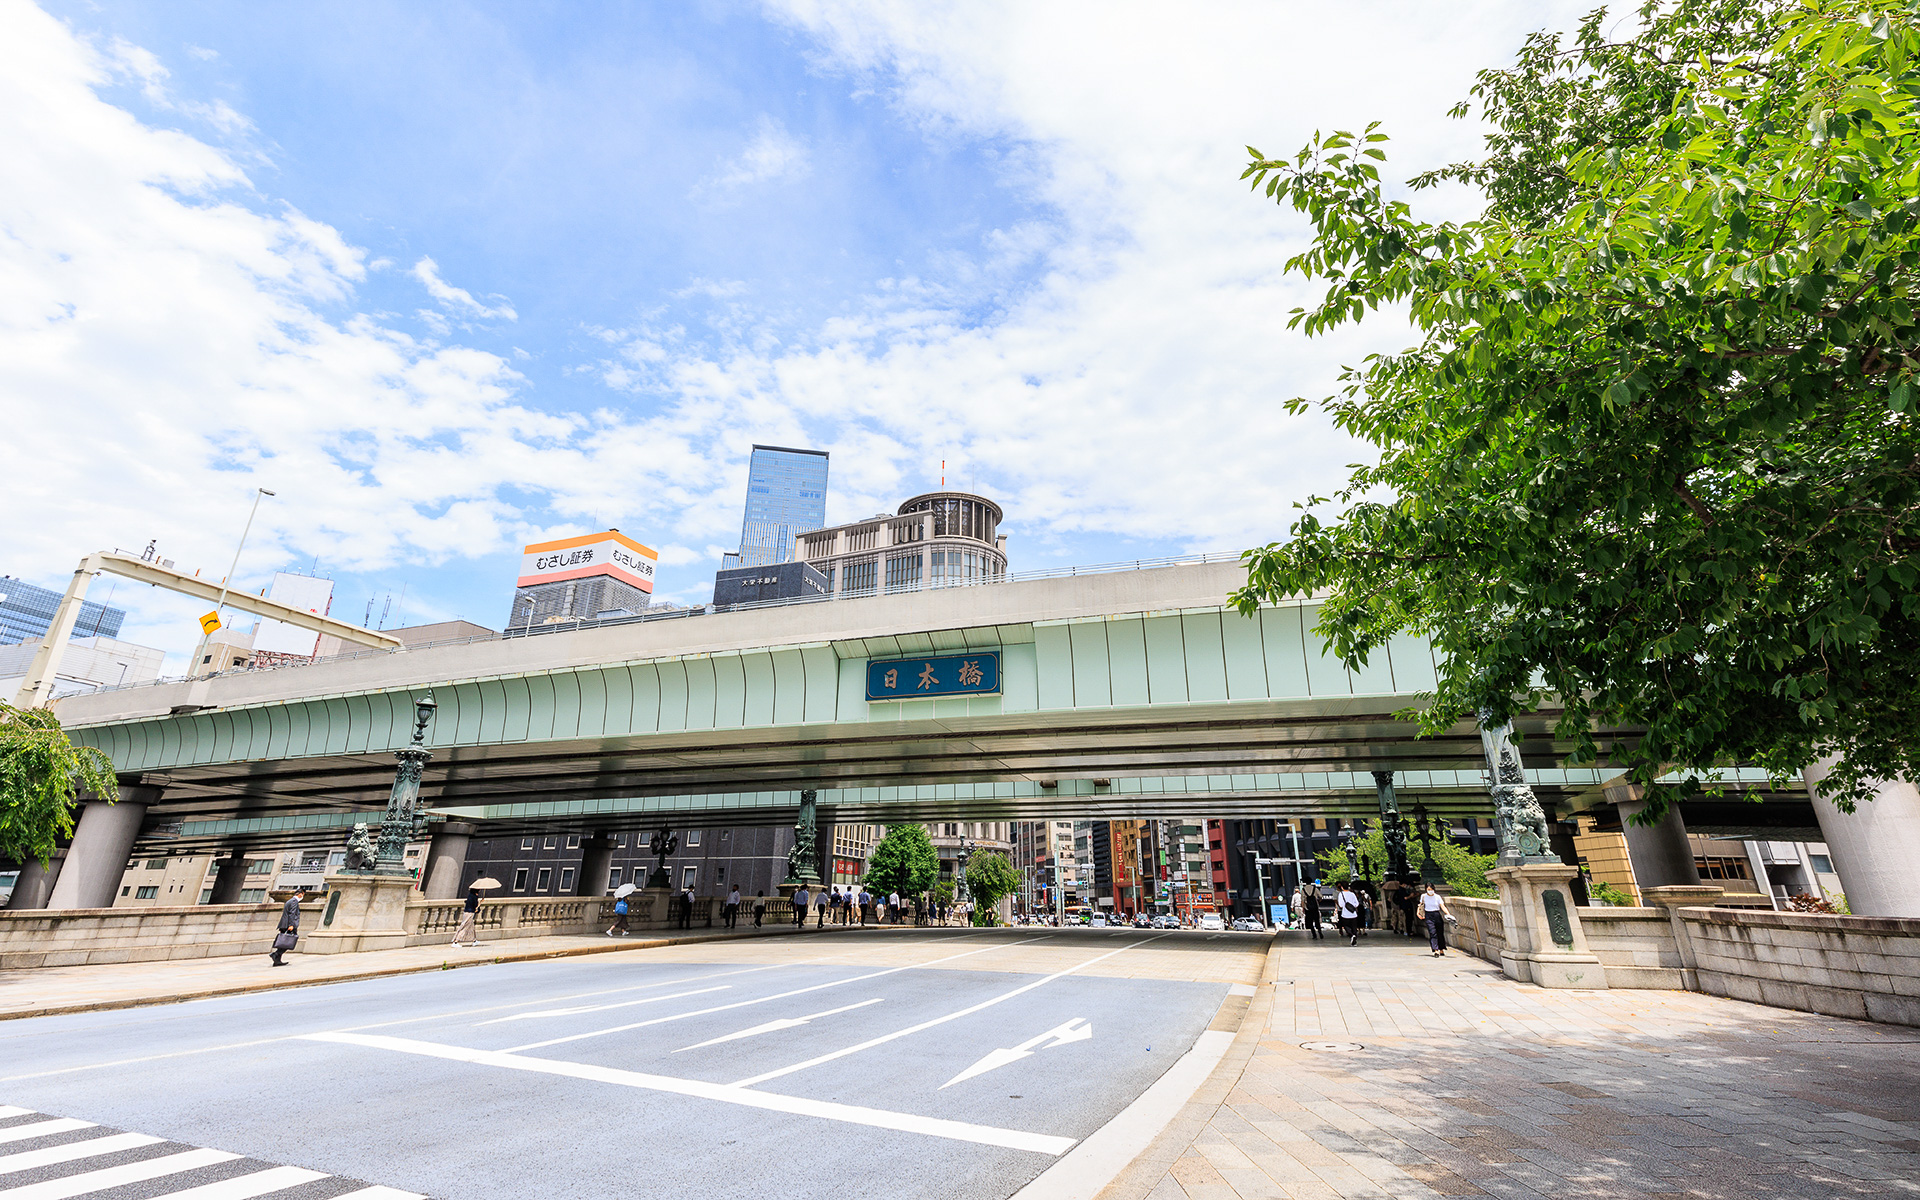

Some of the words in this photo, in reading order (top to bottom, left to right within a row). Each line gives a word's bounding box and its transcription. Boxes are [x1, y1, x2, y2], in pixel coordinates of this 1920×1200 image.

[536, 549, 594, 570] むさし証券
[612, 549, 653, 576] むさし証券
[884, 660, 984, 690] 日本橋
